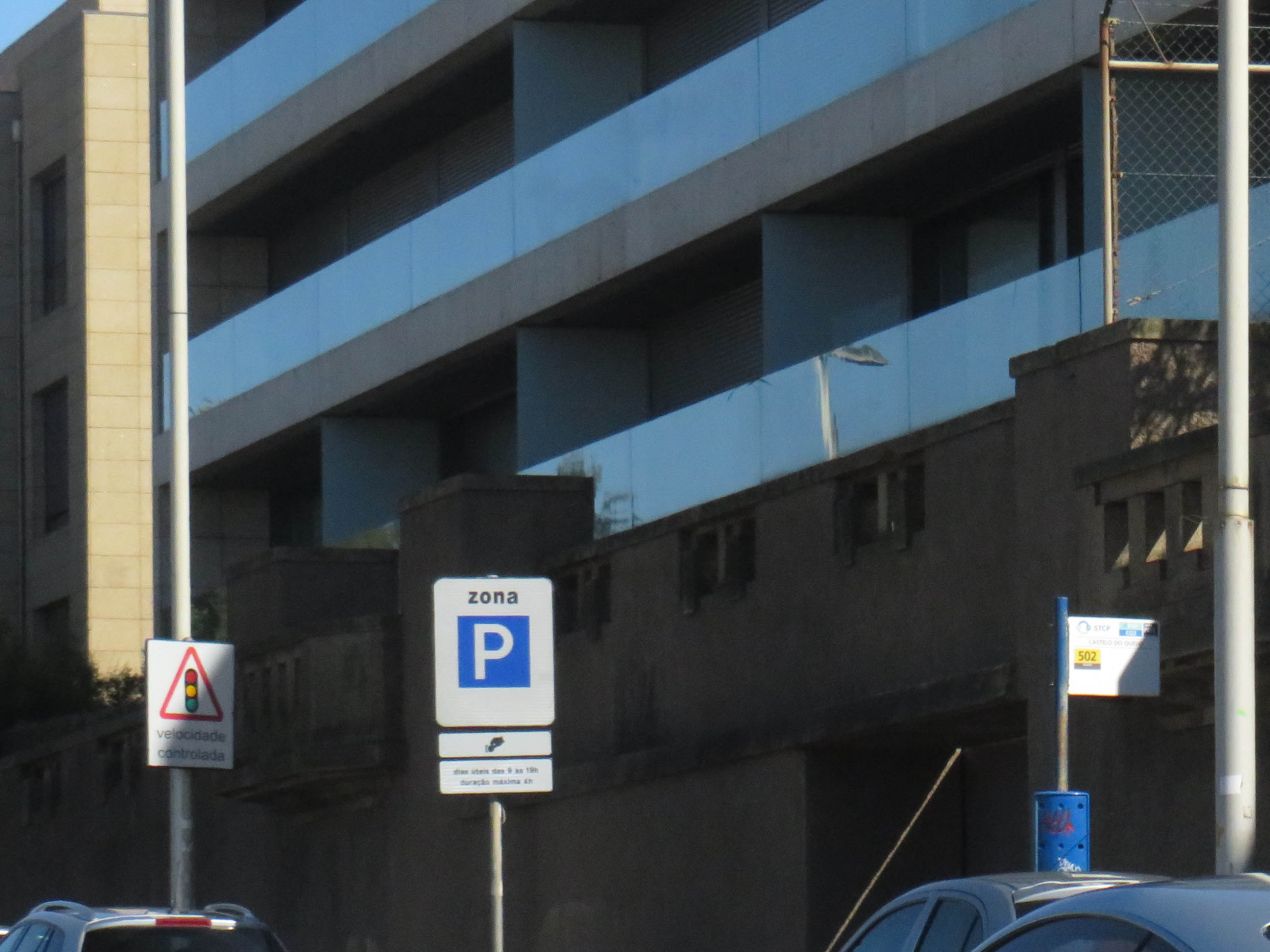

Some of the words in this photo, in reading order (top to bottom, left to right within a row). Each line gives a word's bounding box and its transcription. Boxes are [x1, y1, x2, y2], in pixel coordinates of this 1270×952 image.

[467, 591, 518, 605] zona
[474, 623, 514, 680] P
[1078, 651, 1097, 662] 502
[156, 728, 227, 742] velocidade
[157, 748, 225, 762] controlada
[460, 778, 490, 787] duração
[492, 778, 521, 786] máxima
